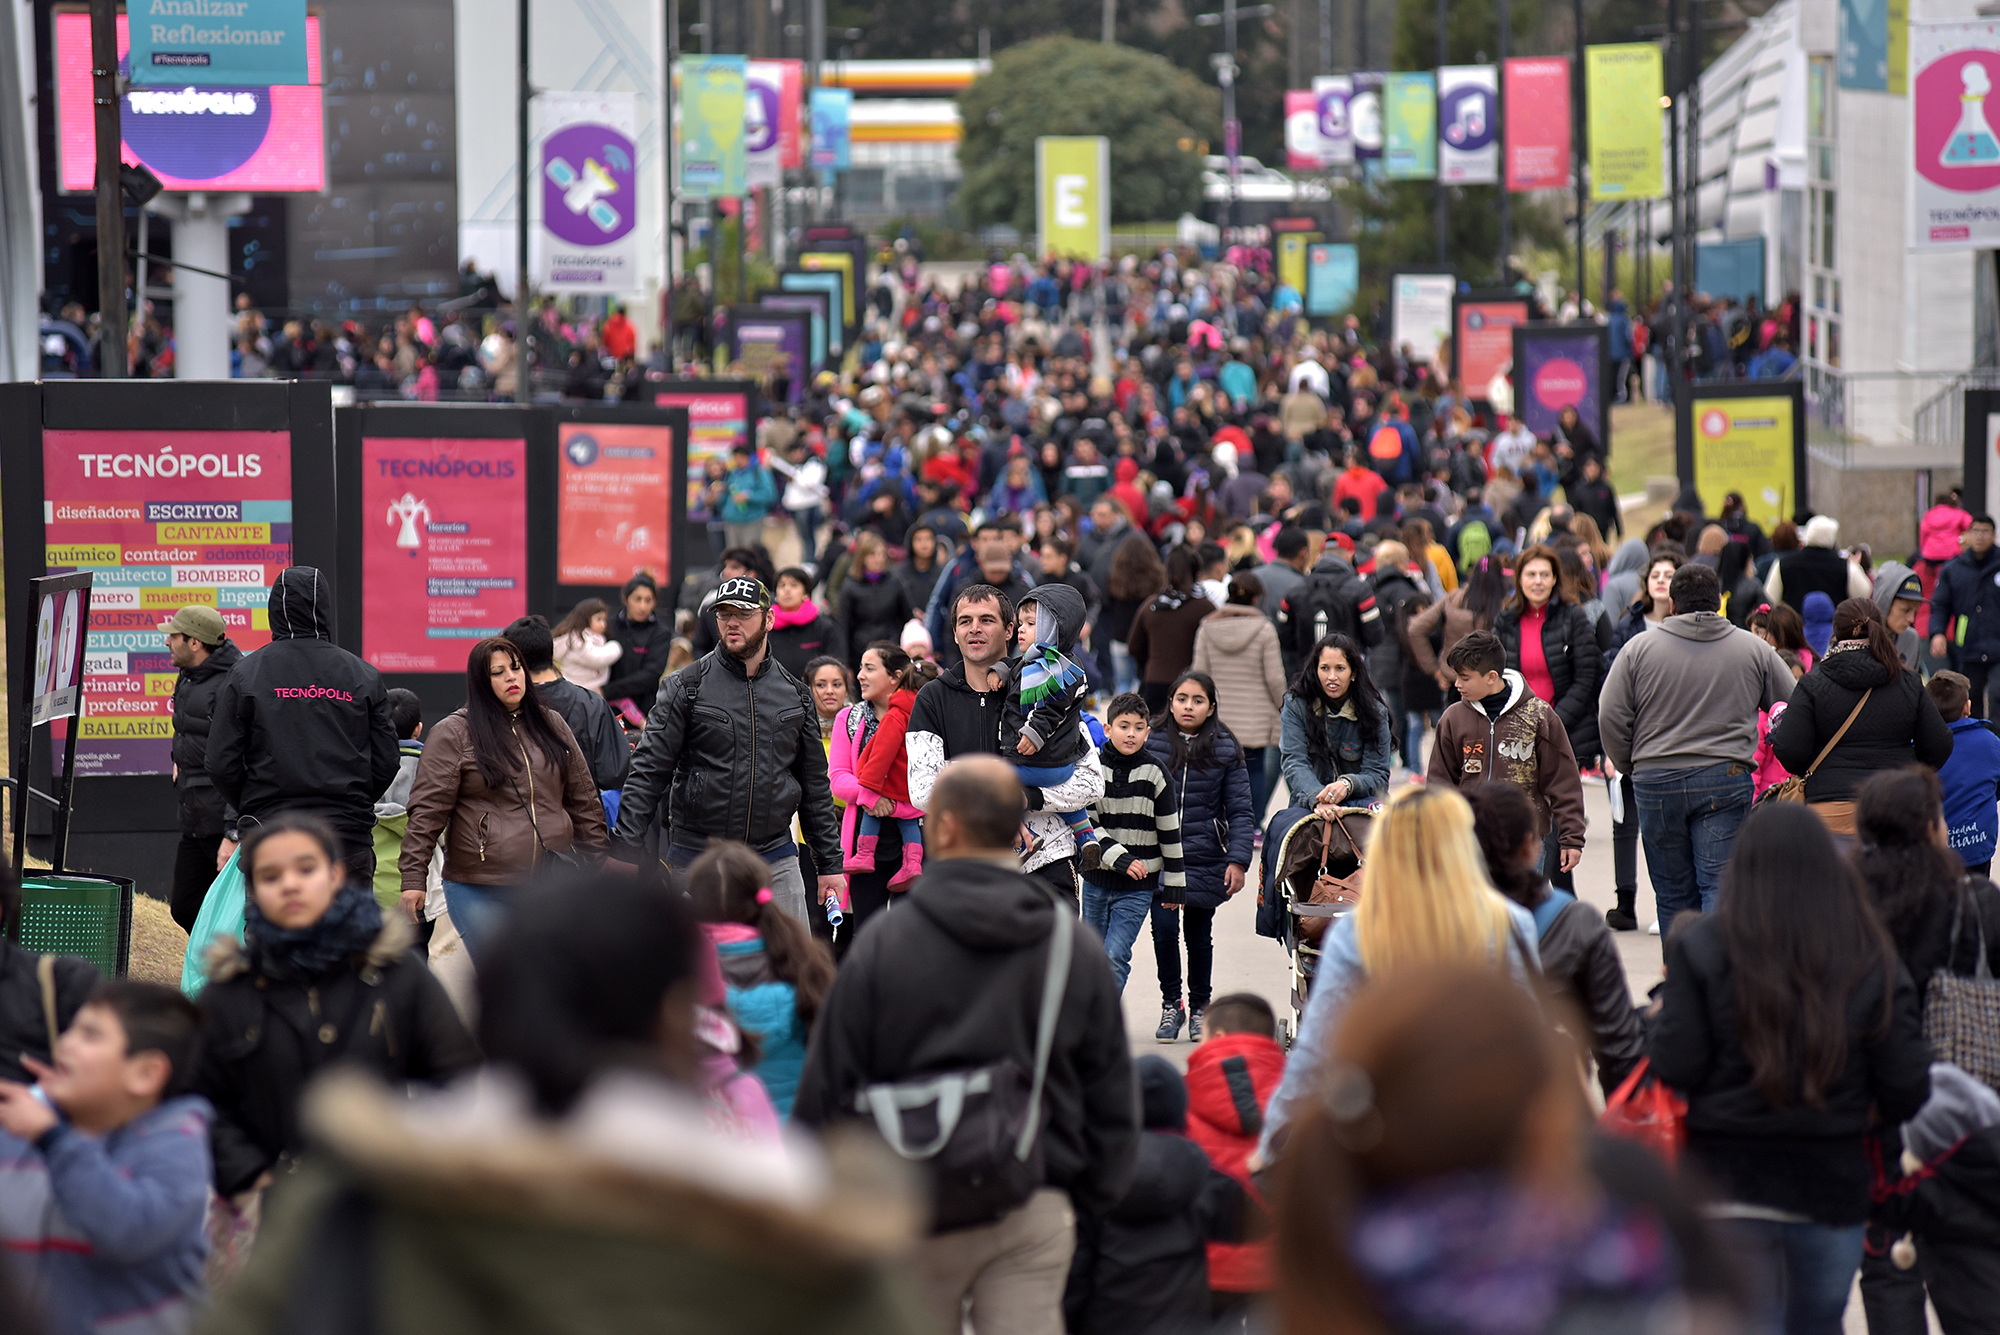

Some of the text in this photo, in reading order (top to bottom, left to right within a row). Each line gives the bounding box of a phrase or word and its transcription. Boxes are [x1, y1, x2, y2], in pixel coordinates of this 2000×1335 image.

[150, 0, 248, 17] Analizar
[151, 25, 285, 45] Reflexionar
[1055, 174, 1088, 227] E
[78, 445, 262, 478] TECNÓPOLIS
[377, 453, 515, 478] TECNÓPOLIS
[56, 504, 239, 520] diseñadora ESCRITOR
[164, 526, 264, 540] CANTANTE
[47, 547, 117, 565] químico
[124, 547, 198, 562] contador
[93, 569, 260, 584] rquitecto BOMBERO
[146, 591, 212, 604] maestro
[220, 588, 270, 607] ingeni
[717, 578, 756, 600] DOPE
[83, 678, 141, 693] rinario
[274, 684, 353, 702] TECNÓPOLIS
[88, 698, 158, 716] profesor
[84, 718, 169, 736] BAILARÍN
[1947, 822, 1979, 836] ciedad
[1946, 831, 1987, 849] liana
